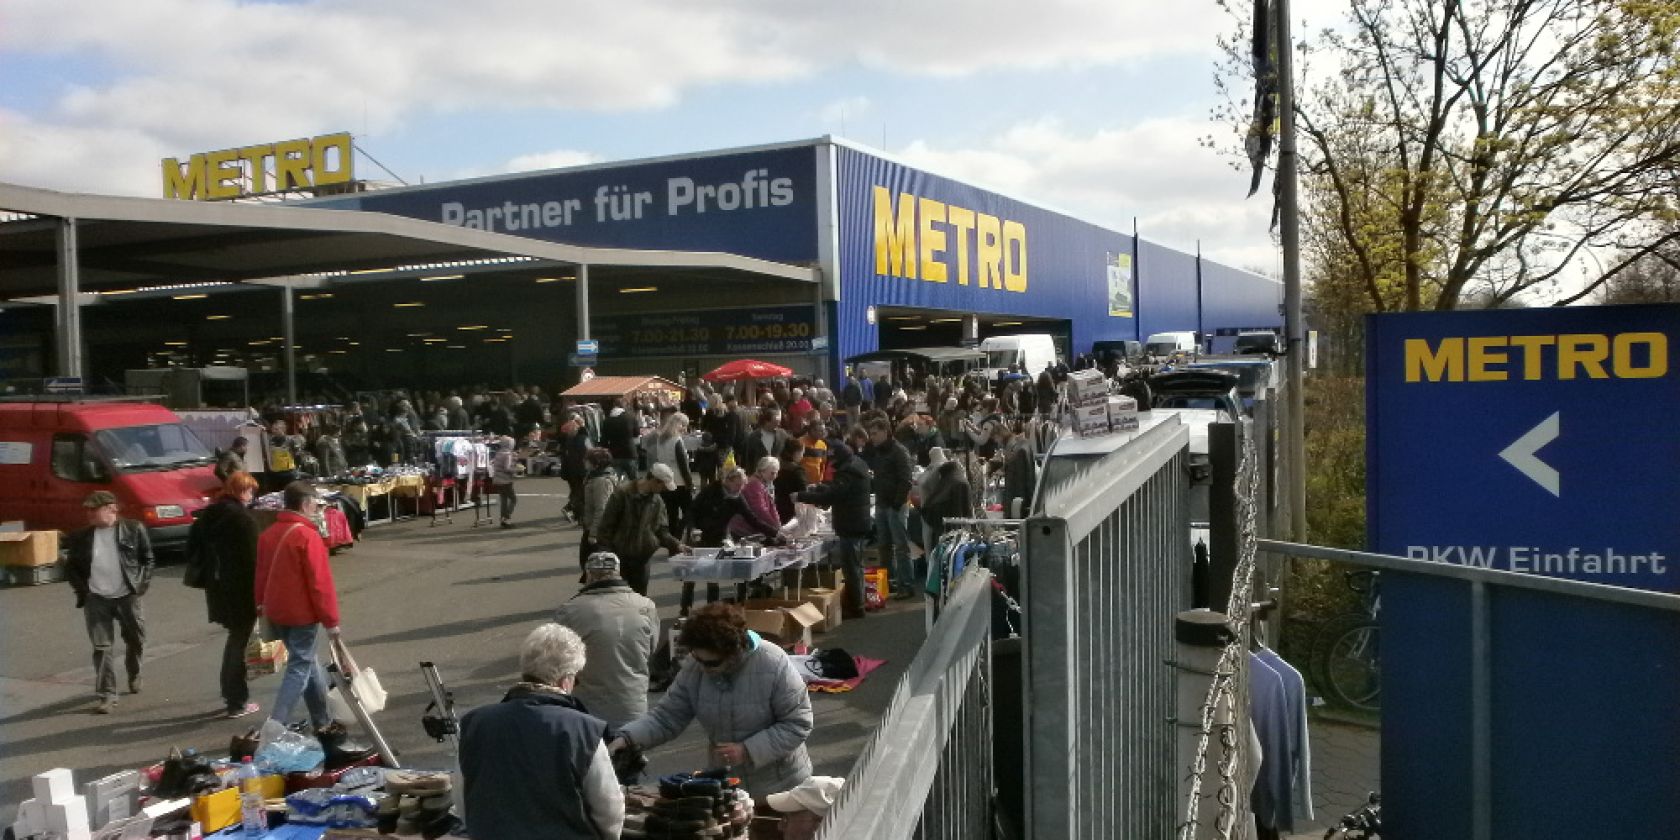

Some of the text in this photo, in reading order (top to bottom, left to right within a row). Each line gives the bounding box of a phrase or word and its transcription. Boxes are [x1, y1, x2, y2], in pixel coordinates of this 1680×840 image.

[162, 132, 352, 200] METRO
[442, 168, 794, 232] Partner für Profis
[874, 185, 1028, 293] METRO
[724, 322, 809, 340] 7.00-19.30
[1404, 332, 1669, 383] METRO
[1407, 545, 1666, 574] PKW Einfahrt
